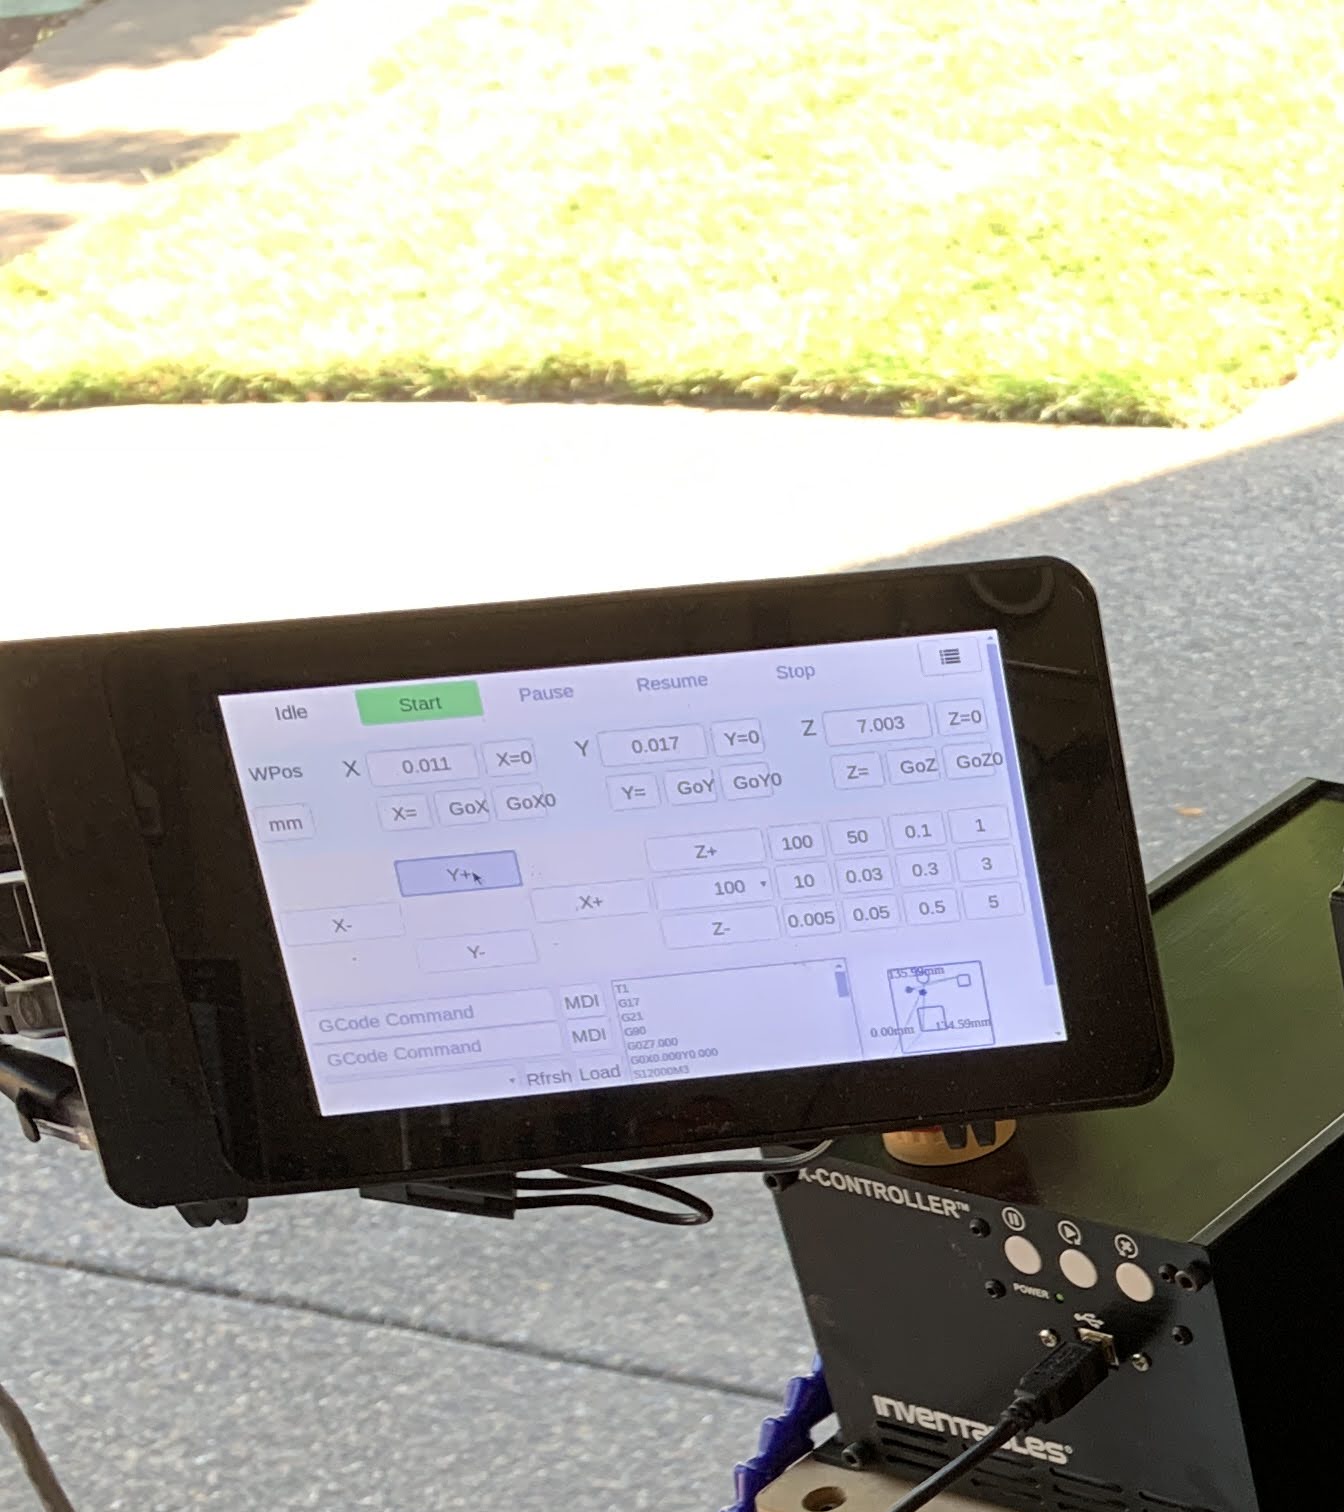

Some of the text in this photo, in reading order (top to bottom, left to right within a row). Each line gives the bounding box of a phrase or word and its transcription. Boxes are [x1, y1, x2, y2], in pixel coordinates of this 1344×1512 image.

[776, 664, 816, 680] Stop
[636, 674, 708, 692] Resume
[519, 685, 574, 702] Pause
[275, 704, 308, 721] Idle
[399, 696, 442, 713] Start
[801, 710, 982, 737] Z 7.003 Z=0
[574, 730, 760, 756] Y 0.017 Y=0
[343, 750, 532, 777] X 0.011 X=0
[900, 758, 937, 774] GoZ
[956, 752, 1003, 769] GoZ0
[249, 765, 304, 782] WPos
[846, 765, 869, 779] Z=
[677, 778, 715, 795] GoY
[733, 772, 782, 790] GoY0
[621, 785, 646, 800] Y=
[449, 799, 490, 816] GoX
[506, 793, 556, 811] GoX0
[392, 807, 417, 821] X=
[269, 815, 303, 831] mm
[975, 819, 986, 833] 1
[847, 830, 869, 844] 50
[905, 824, 932, 839] 0.1
[781, 835, 813, 851] 100
[694, 845, 717, 859] Z+
[911, 862, 939, 877] 0.3
[981, 857, 993, 871] 3
[447, 868, 471, 881] Y+
[794, 874, 815, 889] 10
[846, 867, 883, 884] 0.03
[714, 880, 745, 895] 100
[579, 895, 603, 910] X+
[919, 900, 946, 916] 0.5
[988, 895, 999, 909] 5
[787, 911, 835, 929] 0.005
[853, 906, 890, 922] 0.05
[332, 918, 352, 932] X-
[712, 922, 731, 936] Z-
[466, 945, 485, 959] Y-
[564, 994, 600, 1010] MDI
[618, 998, 640, 1008] G17
[318, 1005, 475, 1033] GCode Command
[621, 1012, 644, 1023] G21
[571, 1028, 606, 1044] MDI
[327, 1040, 483, 1067] GCode Command
[526, 1068, 573, 1087] Rfrsh
[579, 1064, 621, 1081] Load
[1013, 1282, 1050, 1299] POWER
